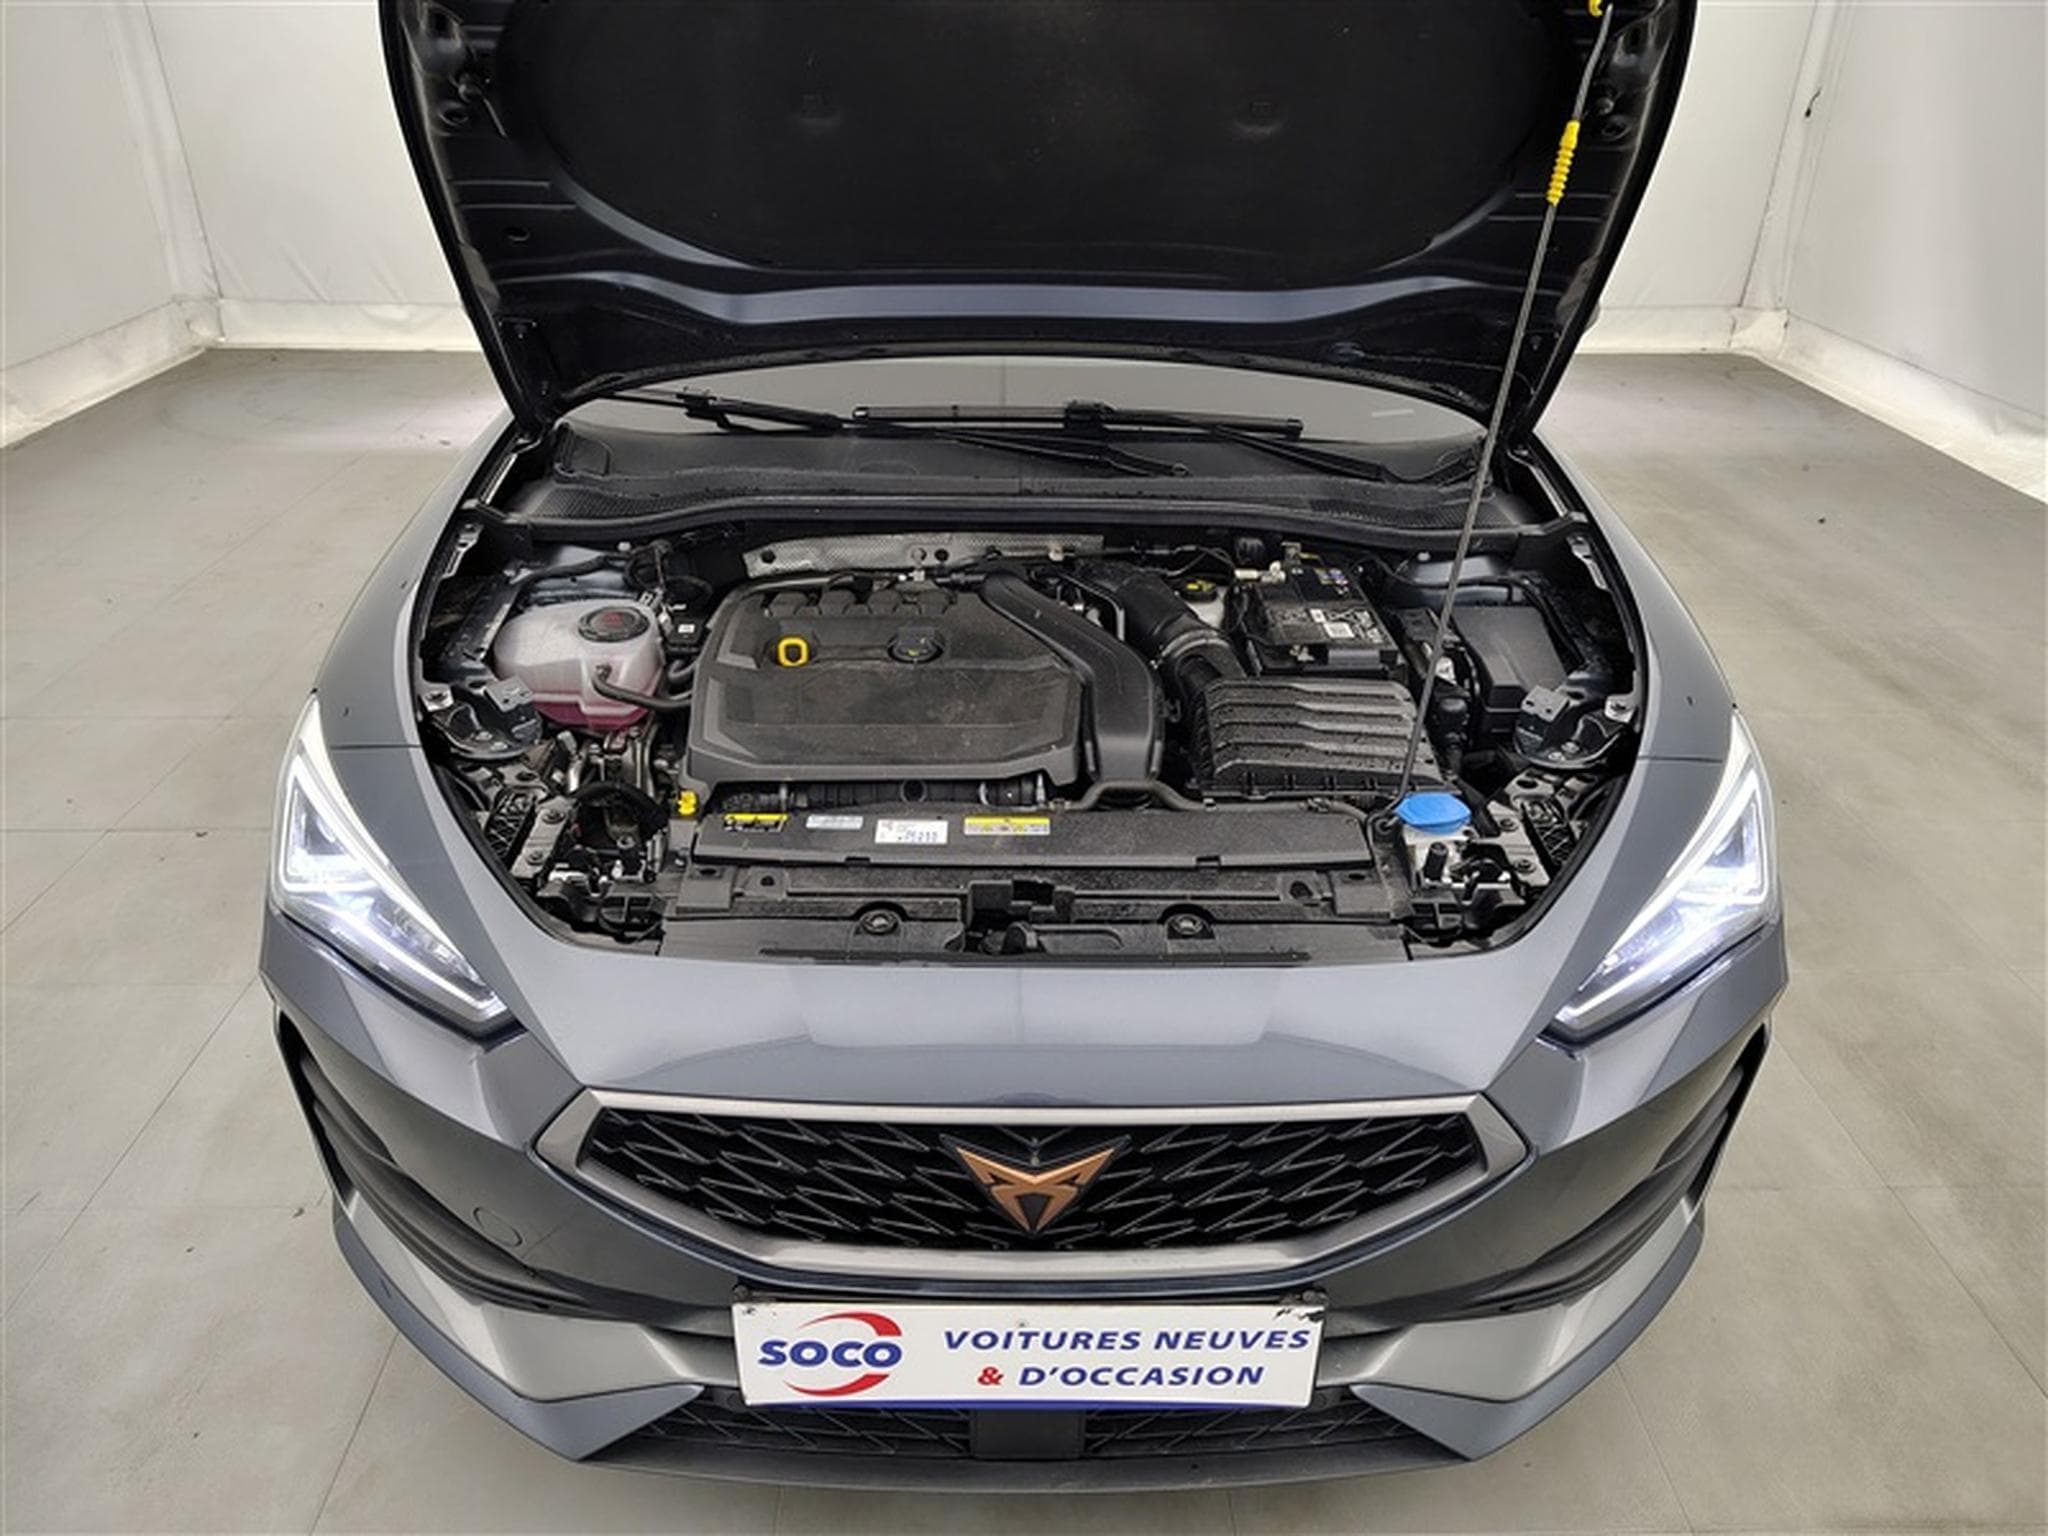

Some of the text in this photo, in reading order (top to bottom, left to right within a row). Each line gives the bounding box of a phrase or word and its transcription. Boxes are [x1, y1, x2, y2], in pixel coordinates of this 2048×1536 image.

[943, 1329, 1311, 1351] VOITURES NEUVES
[758, 1339, 903, 1367] SOCO
[976, 1366, 1265, 1386] & D'OCCASION
